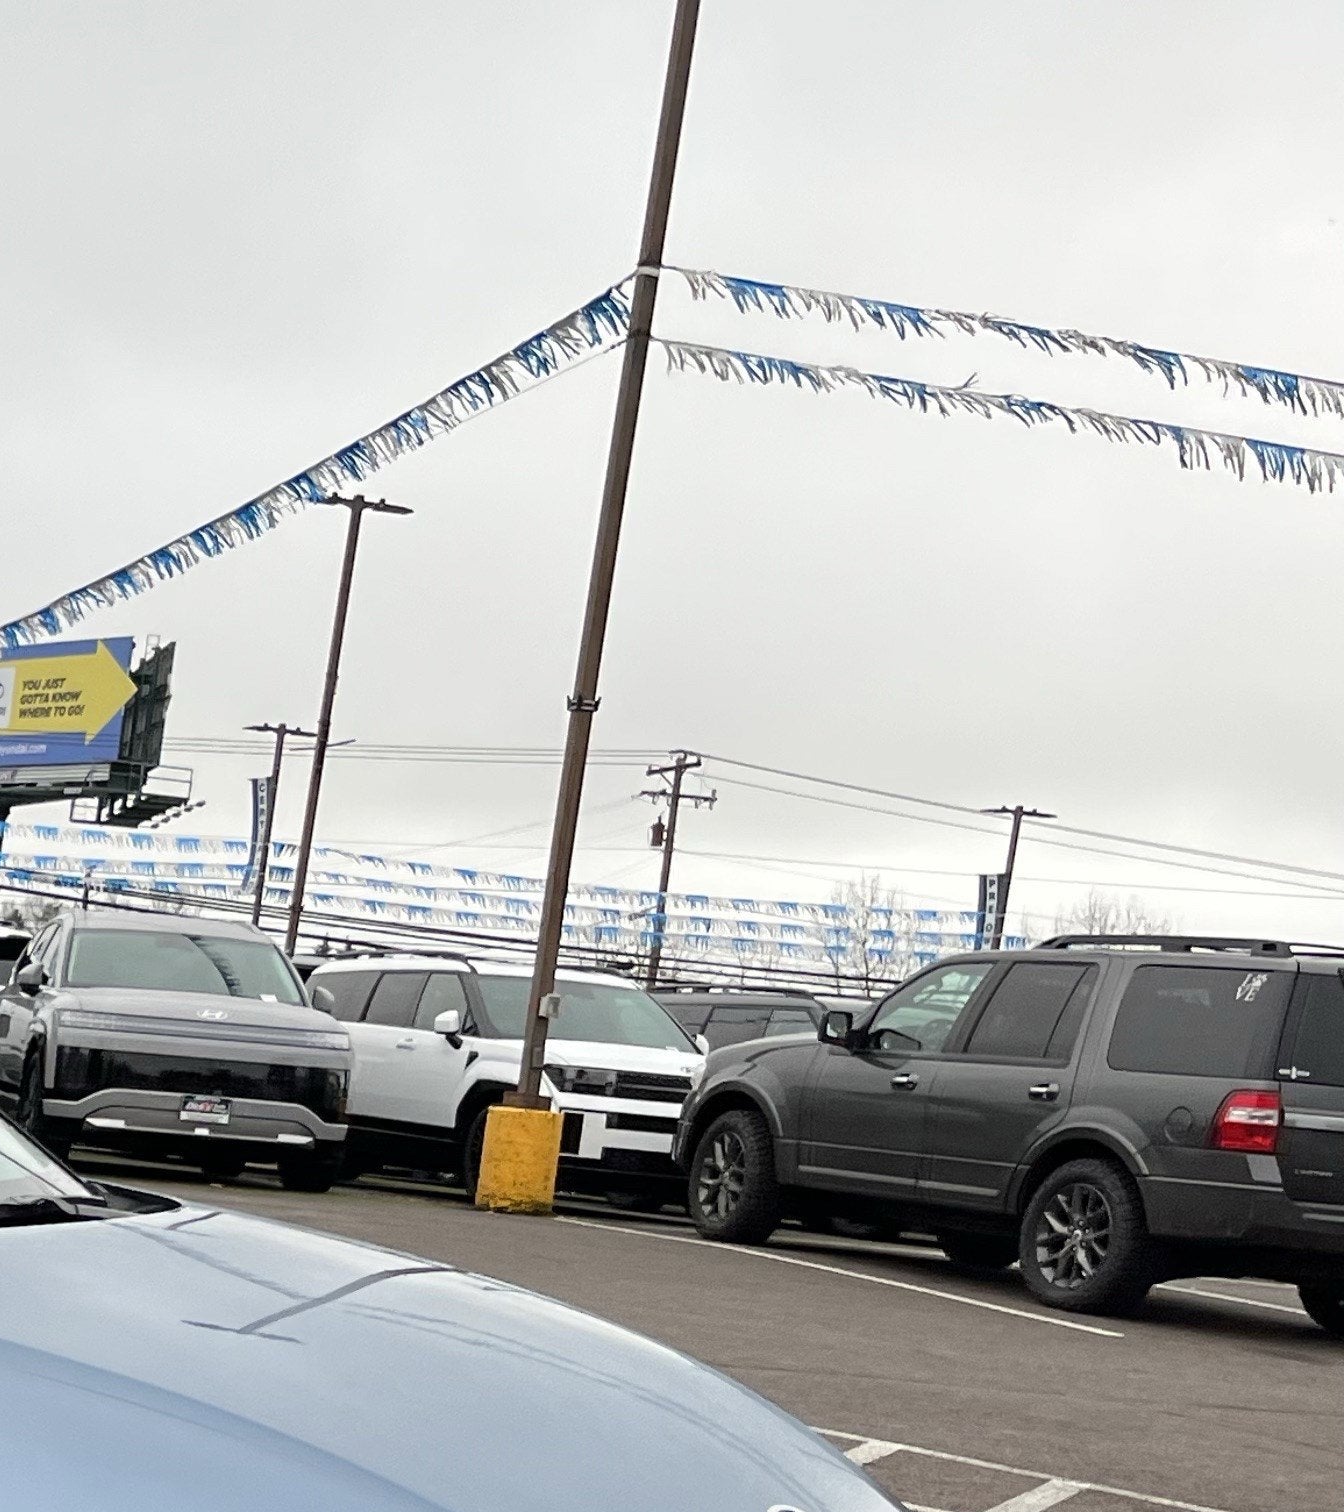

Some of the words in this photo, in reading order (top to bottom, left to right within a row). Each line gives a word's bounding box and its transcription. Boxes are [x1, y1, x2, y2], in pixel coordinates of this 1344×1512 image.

[22, 679, 41, 691] YOU
[42, 677, 67, 690] JUST
[53, 706, 66, 718] TO
